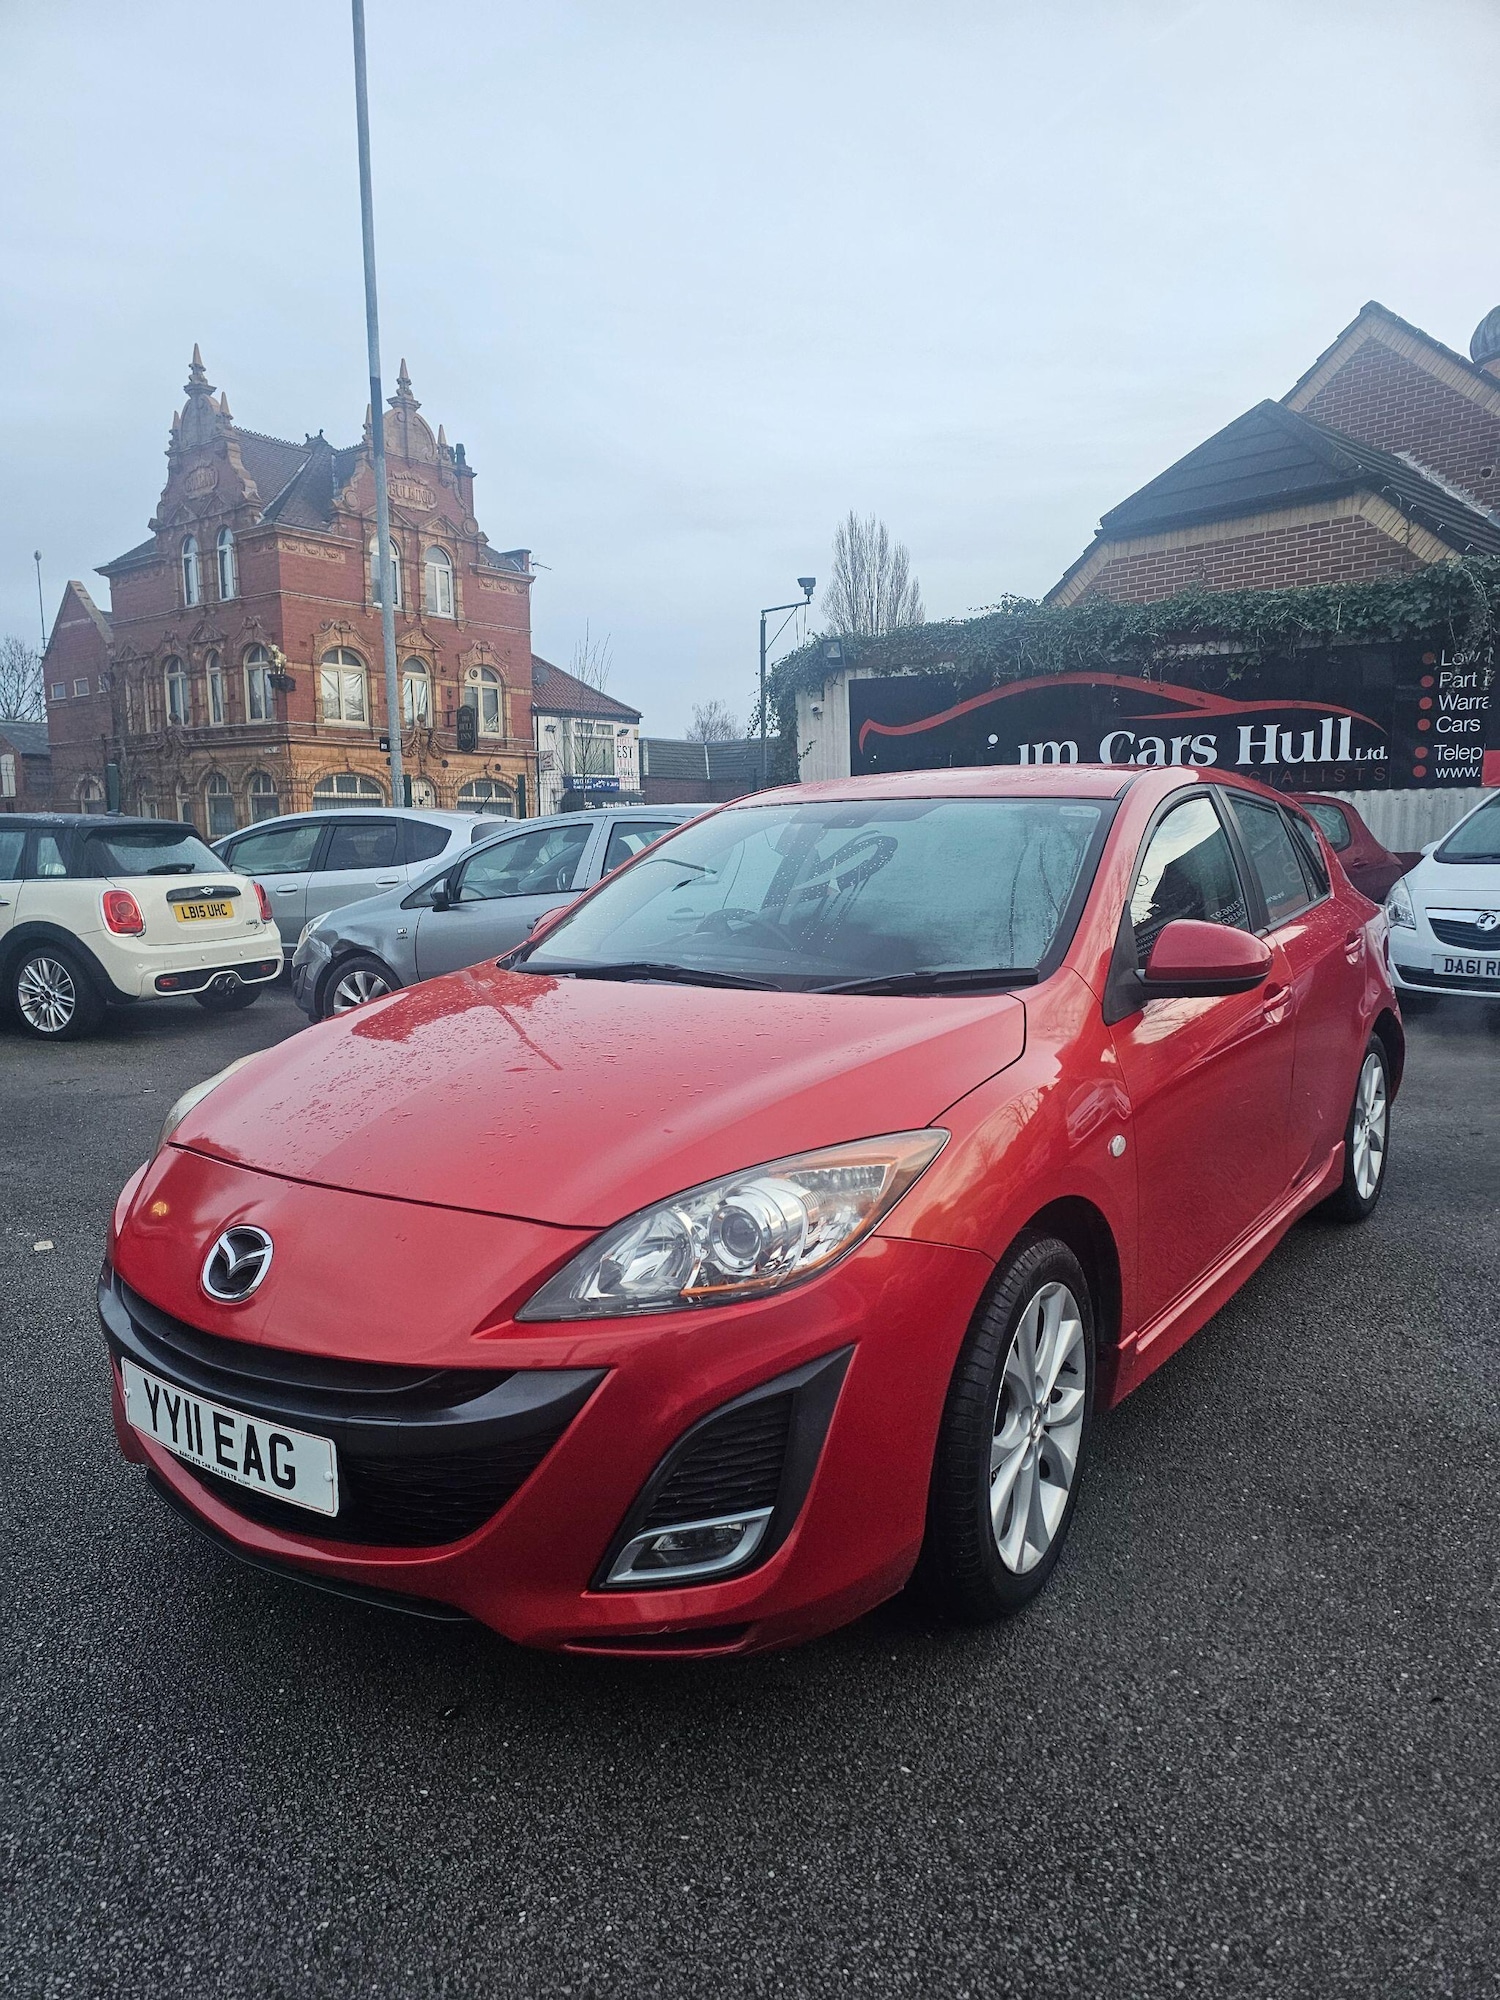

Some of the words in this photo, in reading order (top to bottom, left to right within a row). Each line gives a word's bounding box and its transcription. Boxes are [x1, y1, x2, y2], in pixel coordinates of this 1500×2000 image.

[1439, 672, 1477, 688] Part
[1438, 693, 1490, 710] Warra
[1435, 715, 1481, 733] Cars
[1099, 730, 1218, 766] Cars
[1234, 716, 1352, 765] Hull
[1354, 745, 1389, 761] Ltd.
[1434, 744, 1483, 763] Telep
[1248, 767, 1386, 785] CIALISTS
[1435, 766, 1481, 778] www.
[181, 905, 206, 919] LB15
[207, 903, 228, 917] UHC
[1444, 958, 1481, 975] DA61
[1486, 961, 1500, 976] R
[143, 1378, 203, 1456] YY11
[212, 1411, 296, 1491] EAG
